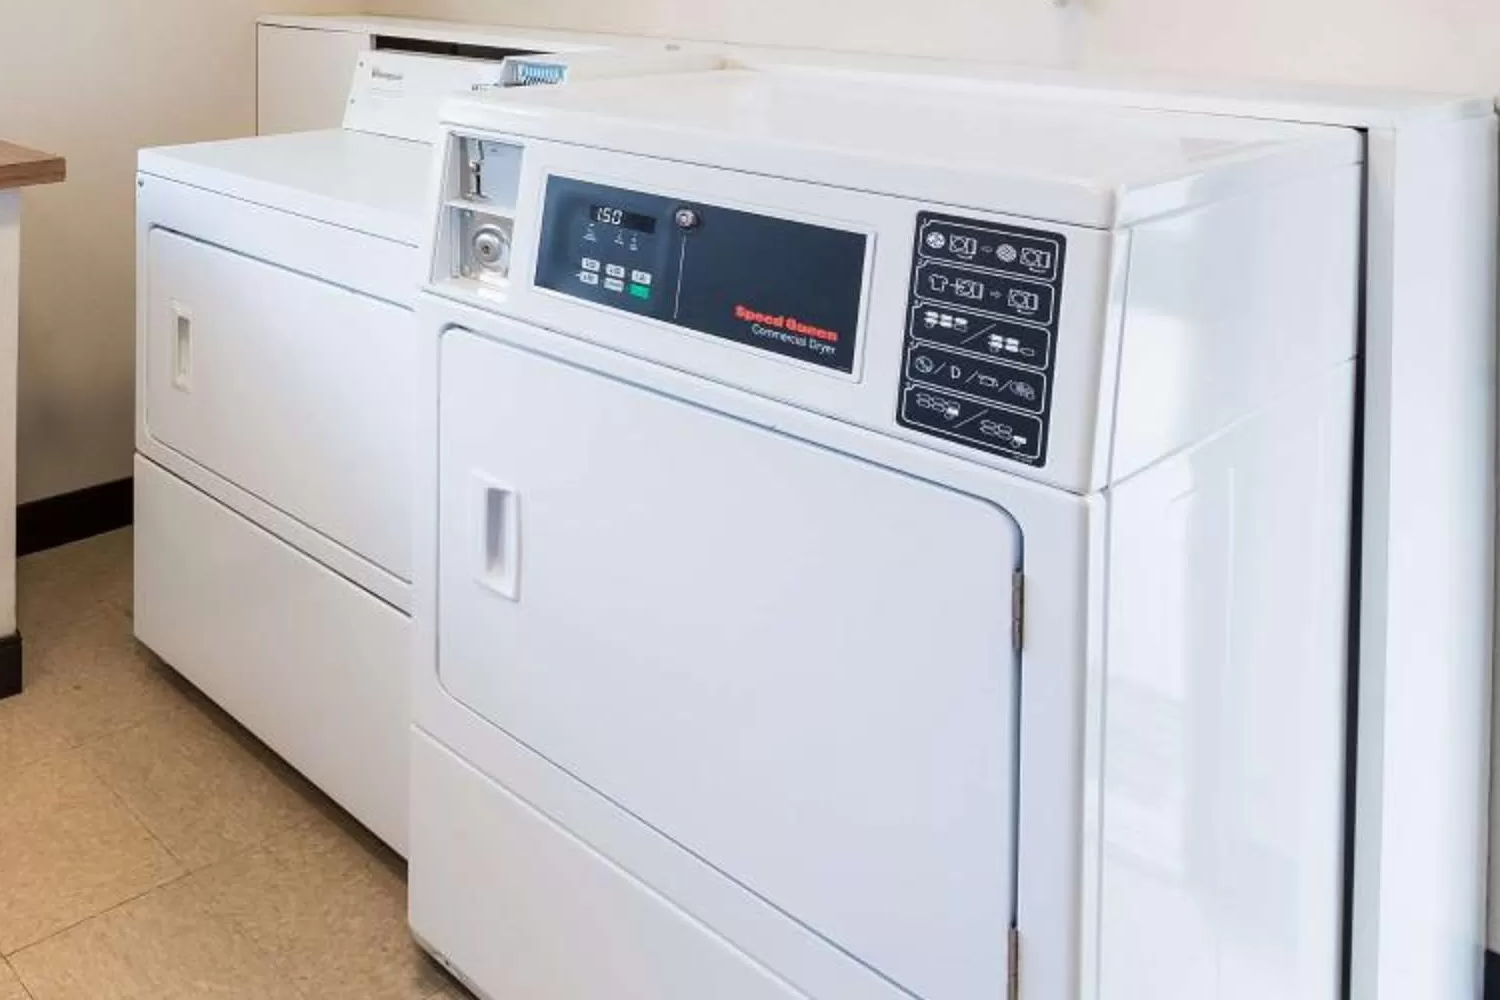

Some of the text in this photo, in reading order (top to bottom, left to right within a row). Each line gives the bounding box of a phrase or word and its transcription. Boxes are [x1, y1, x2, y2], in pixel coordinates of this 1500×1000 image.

[596, 207, 623, 225] 150
[735, 305, 837, 341] Speed Queen
[751, 323, 836, 355] Commercial Dryer
